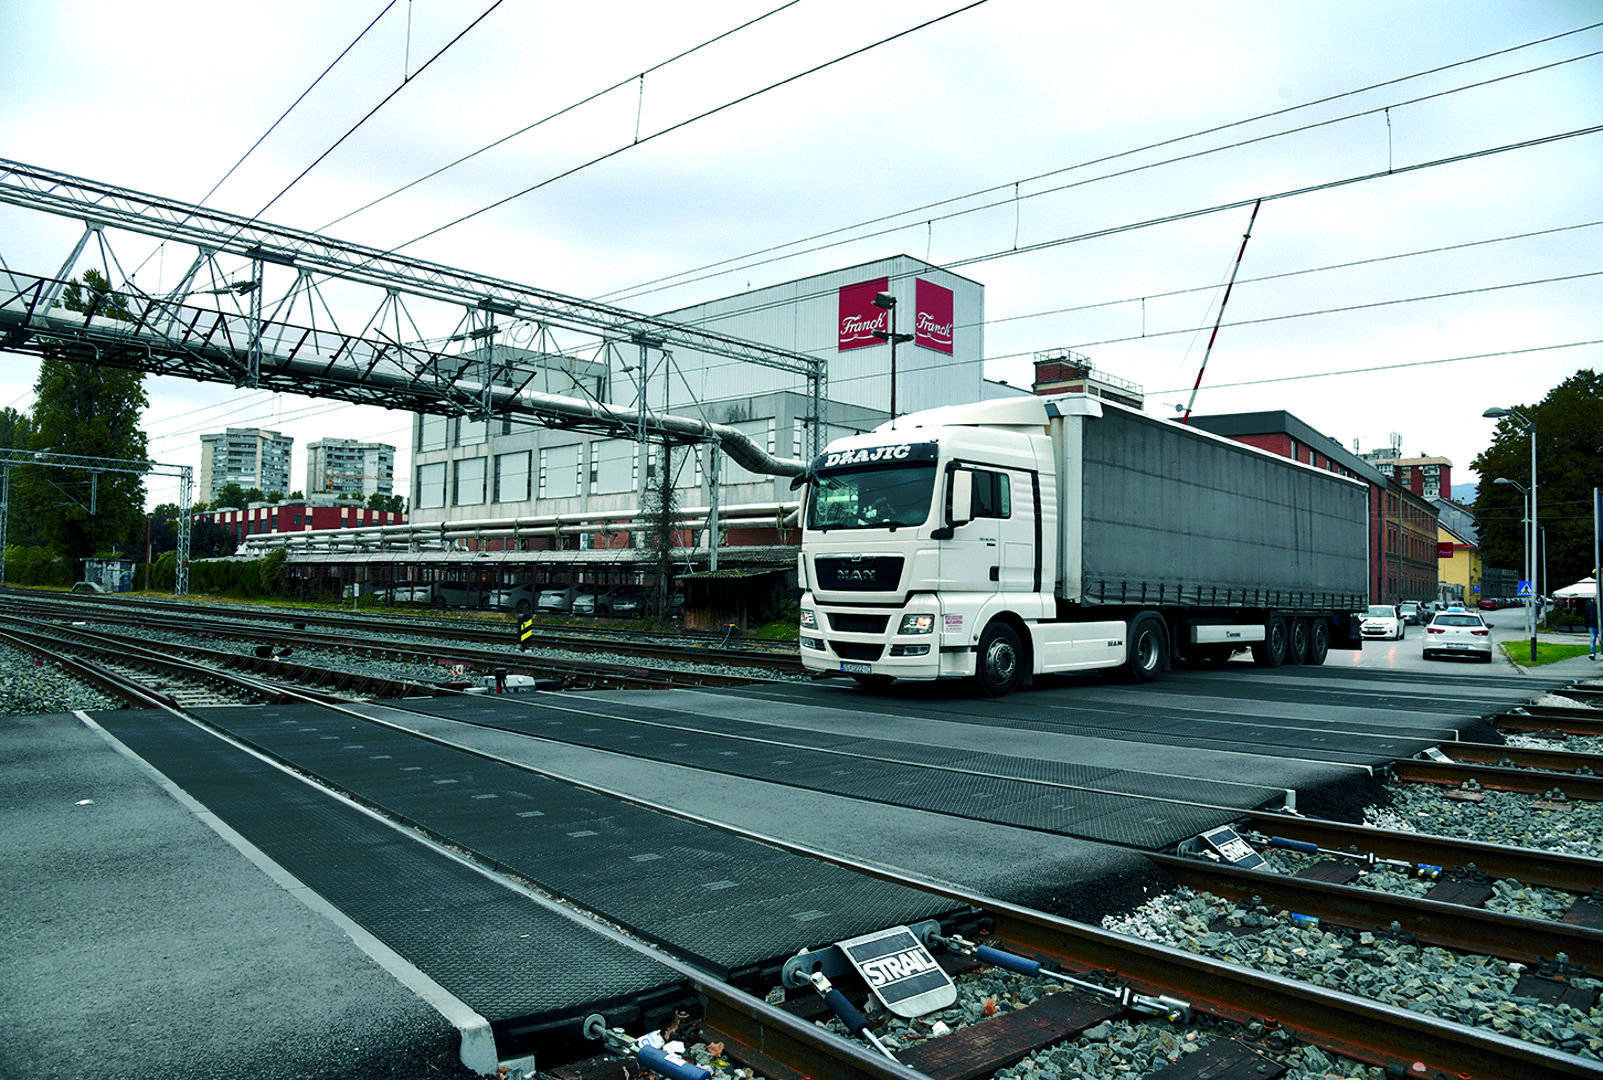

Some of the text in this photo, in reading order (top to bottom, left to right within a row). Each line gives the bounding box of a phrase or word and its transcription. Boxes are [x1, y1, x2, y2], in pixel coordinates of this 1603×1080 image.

[840, 312, 887, 335] Franck
[916, 312, 953, 337] Franck
[837, 569, 876, 581] MAN
[862, 948, 937, 986] STRAIL
